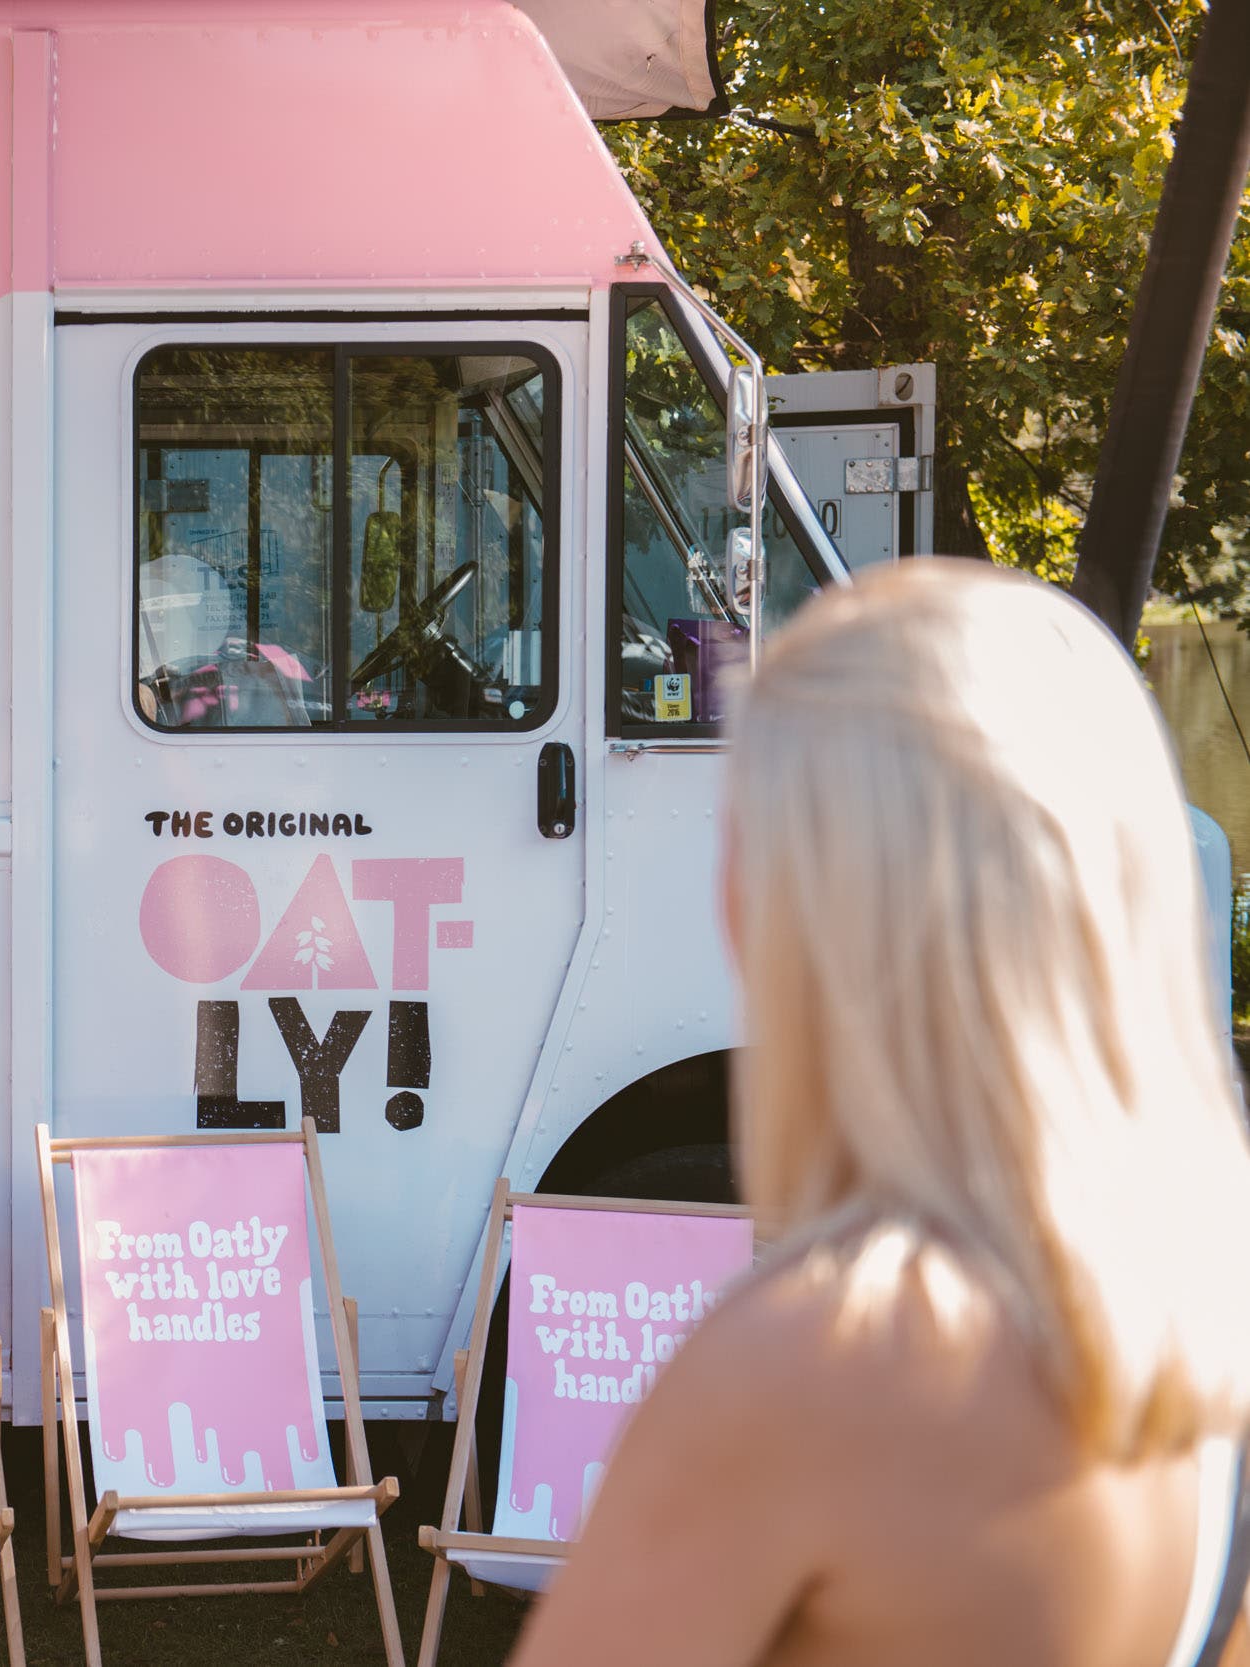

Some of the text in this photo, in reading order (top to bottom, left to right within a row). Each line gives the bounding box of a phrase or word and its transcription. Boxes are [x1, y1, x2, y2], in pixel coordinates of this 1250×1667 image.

[145, 811, 372, 838] THE ORIGINAL
[194, 996, 431, 1134] LY!
[95, 1216, 289, 1266] From Oatly
[105, 1260, 281, 1300] with love
[528, 1273, 619, 1318] From
[126, 1301, 261, 1343] handles
[535, 1318, 631, 1361] with
